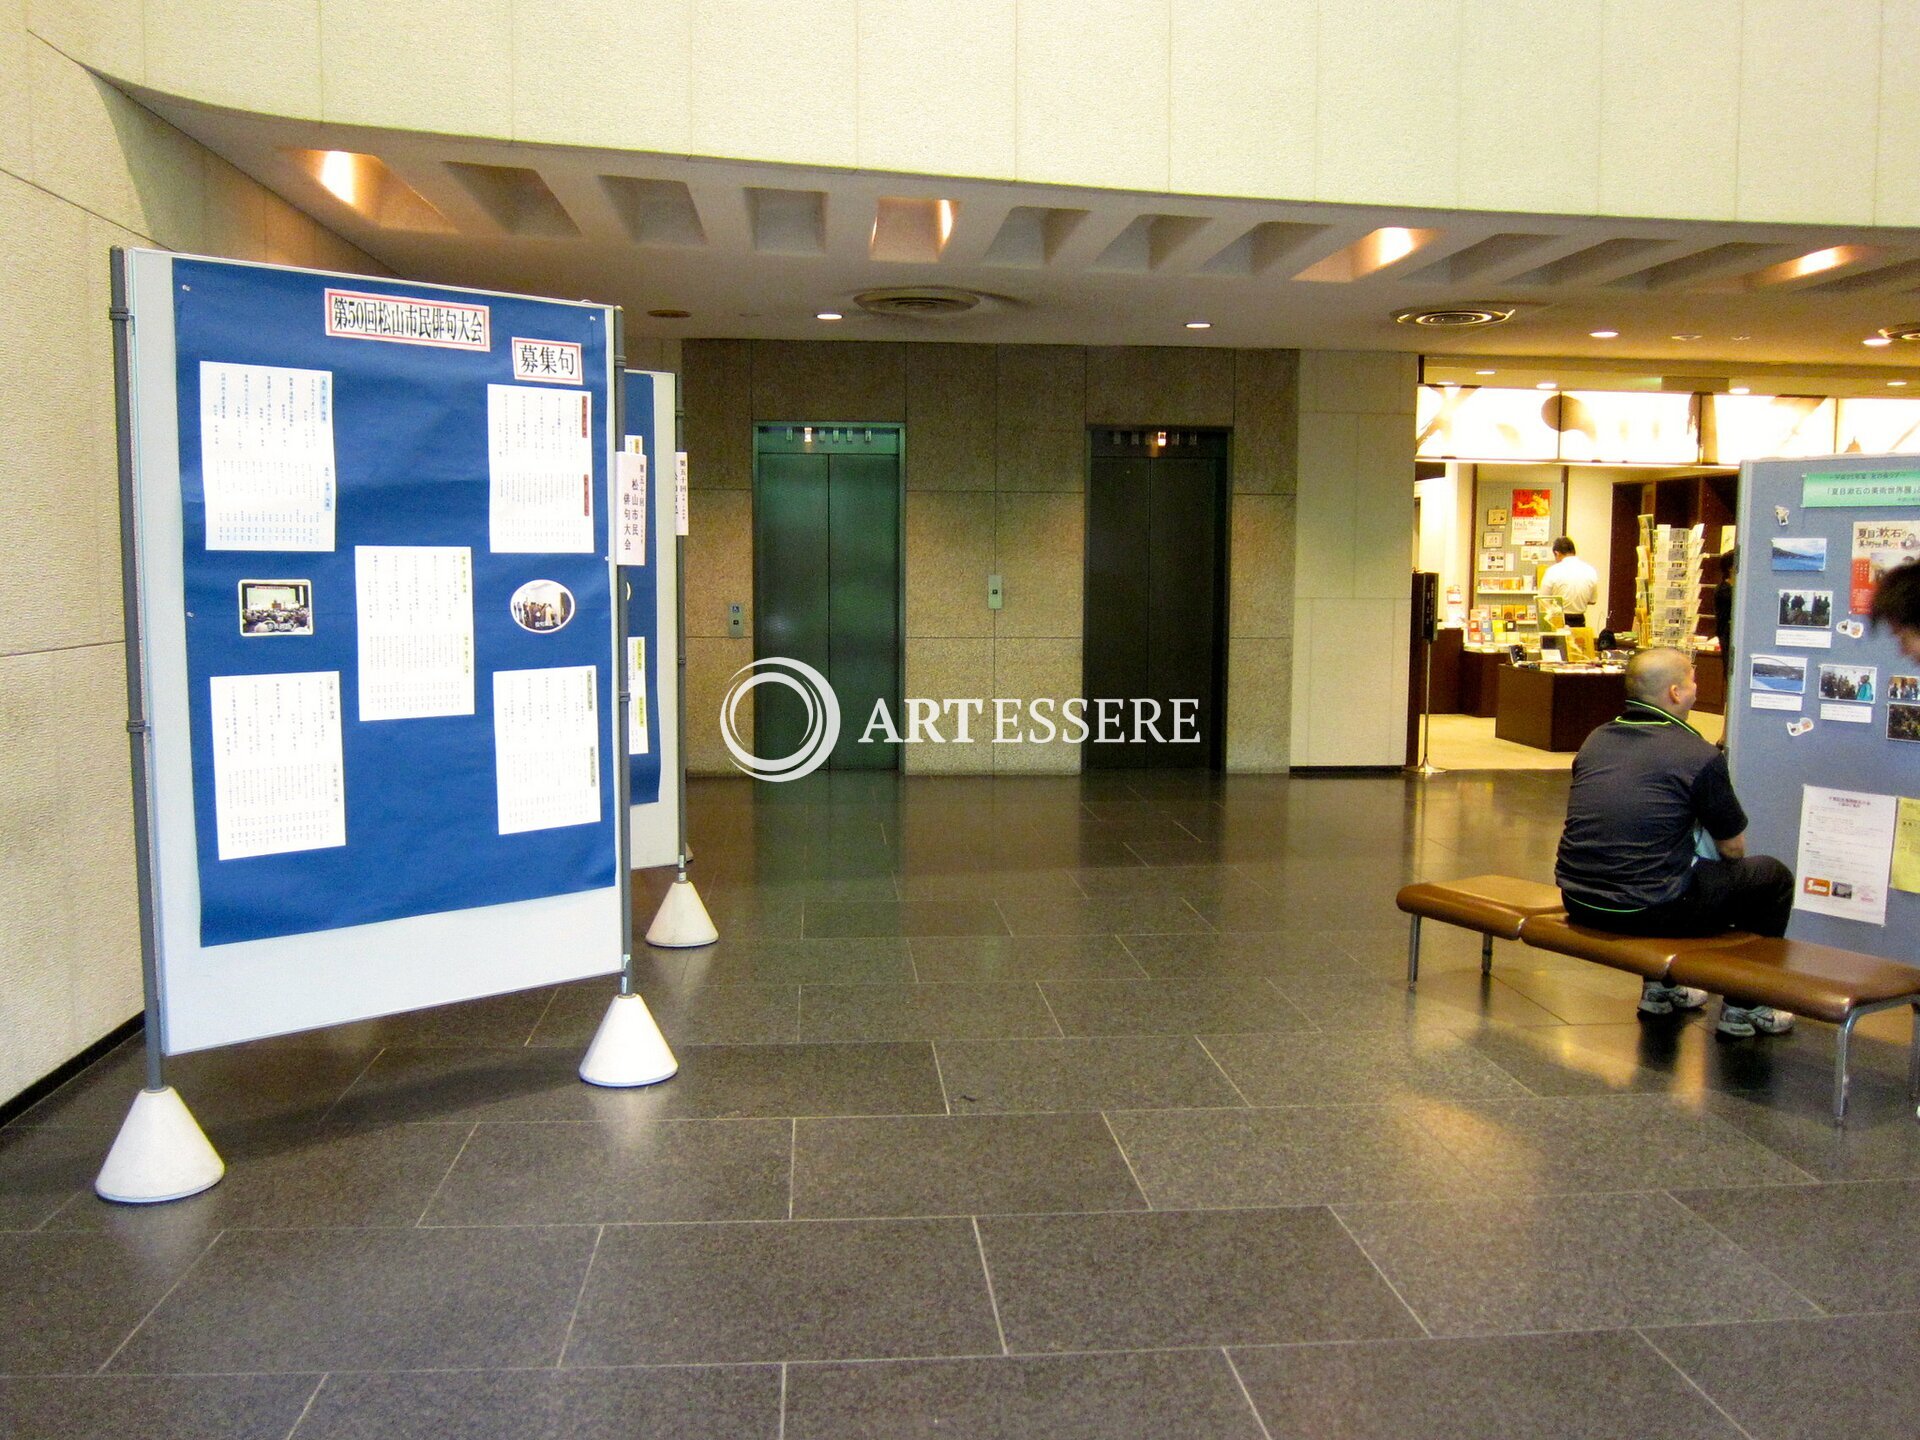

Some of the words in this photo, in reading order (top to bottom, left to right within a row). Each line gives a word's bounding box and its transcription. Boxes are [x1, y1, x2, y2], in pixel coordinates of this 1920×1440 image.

[333, 296, 483, 344] 第50回松山市民俳句大会
[519, 344, 575, 376] 募集句
[623, 493, 632, 550] 俳句大会
[631, 480, 639, 535] 松山市民
